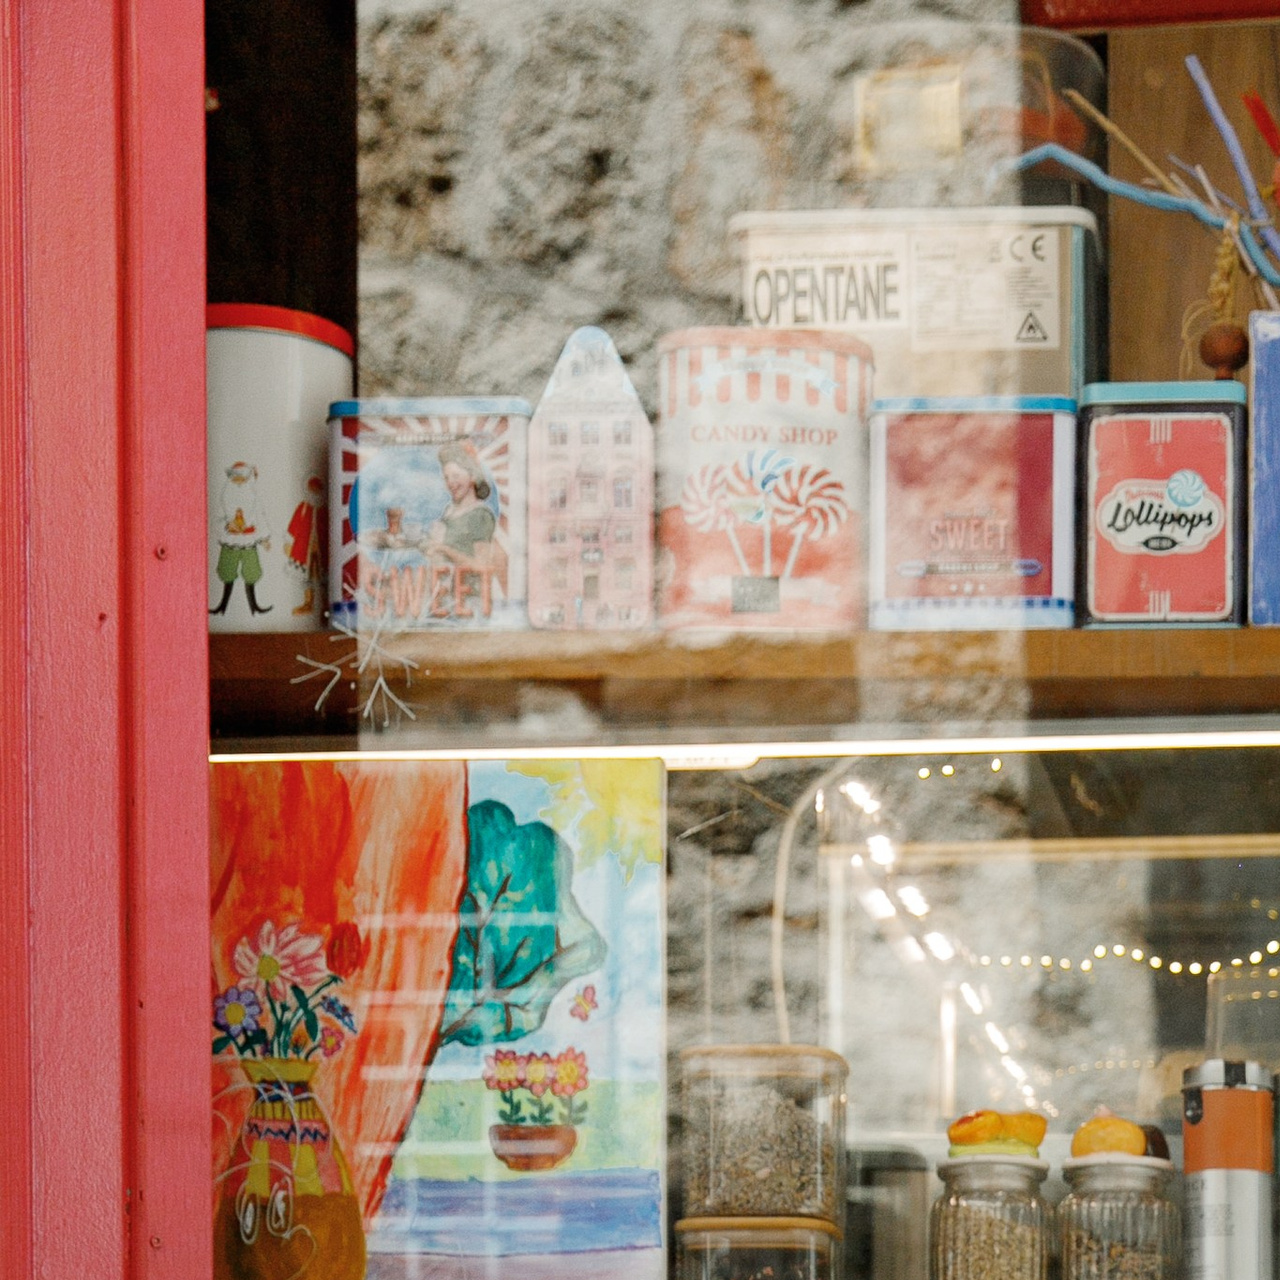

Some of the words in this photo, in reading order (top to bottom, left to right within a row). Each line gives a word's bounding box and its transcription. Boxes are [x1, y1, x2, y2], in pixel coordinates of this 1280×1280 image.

[1009, 233, 1047, 262] CE
[754, 262, 900, 325] OPENTANE
[690, 424, 771, 443] CANDY
[779, 425, 839, 446] SHOP
[931, 518, 1009, 550] SWEET
[1108, 500, 1214, 537] Lollipops
[363, 565, 494, 618] SWEET
